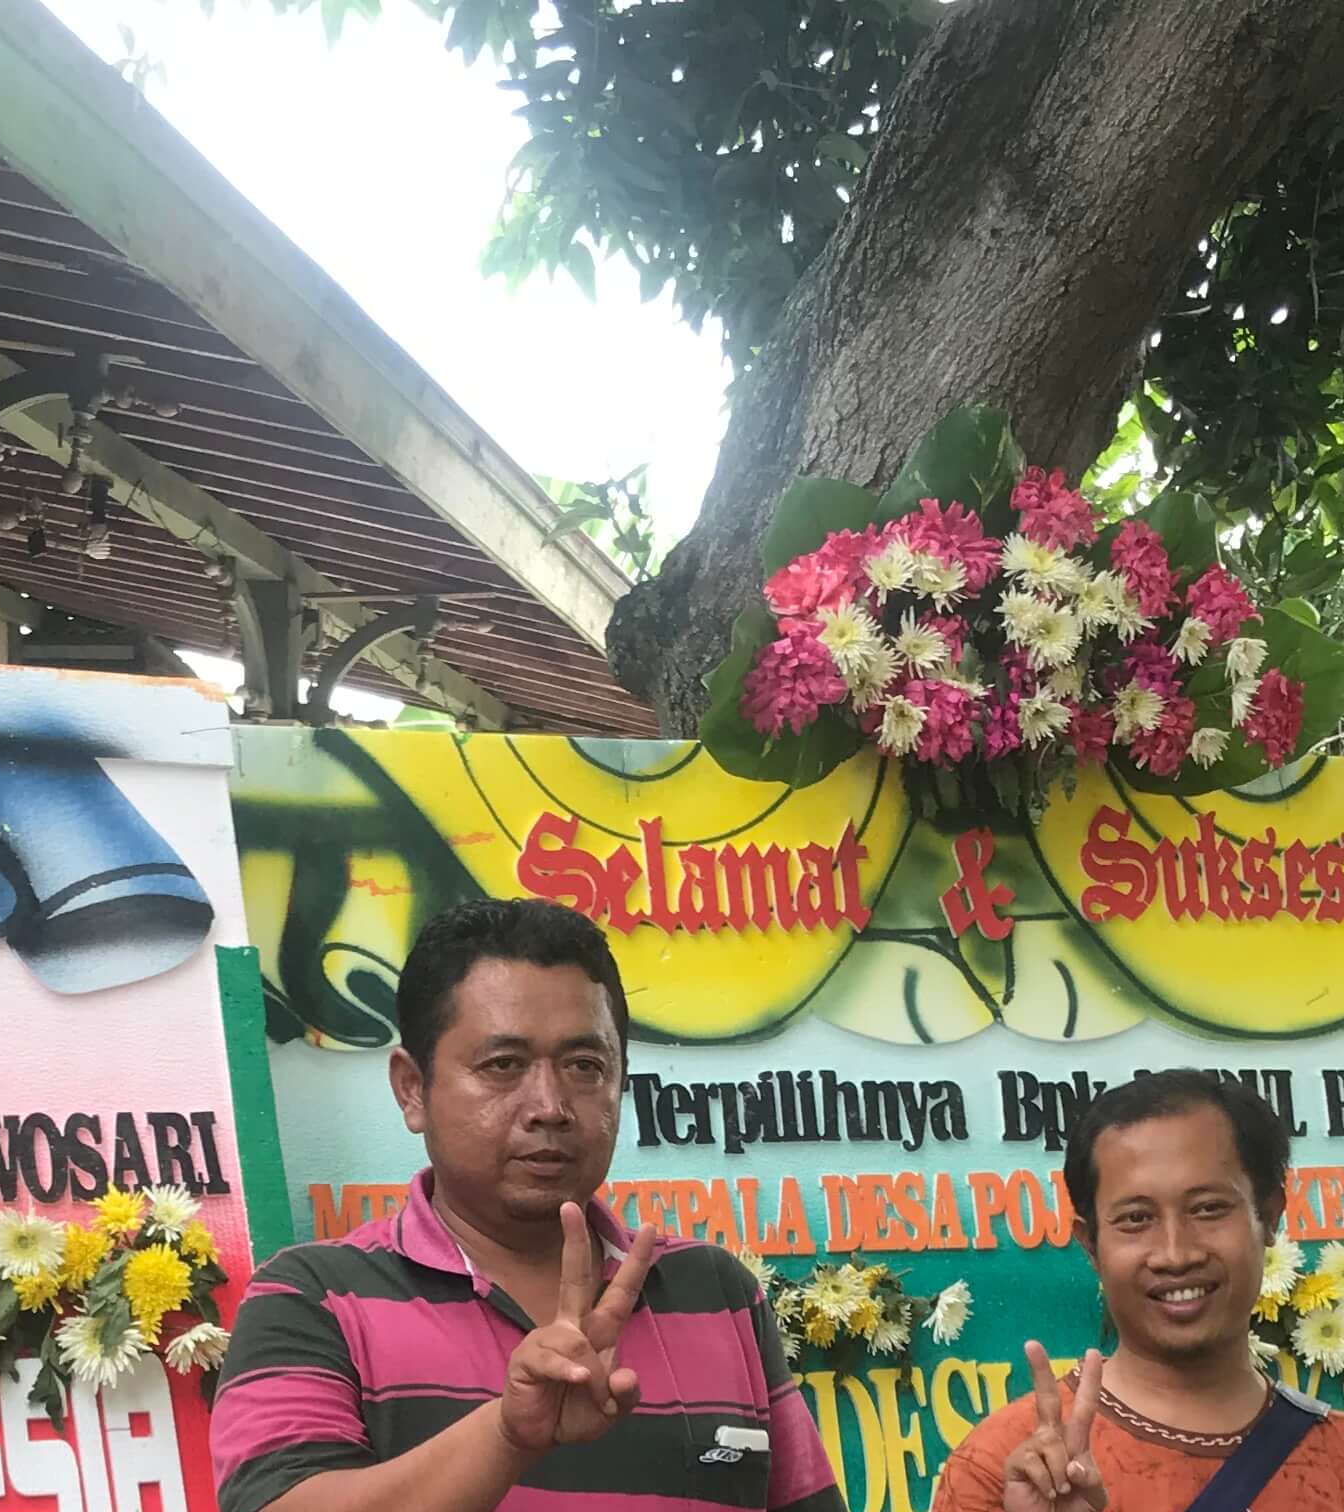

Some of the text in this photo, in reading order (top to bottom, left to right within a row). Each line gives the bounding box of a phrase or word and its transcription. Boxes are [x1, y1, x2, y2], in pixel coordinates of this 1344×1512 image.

[517, 810, 872, 936] Selamat
[939, 826, 1016, 941] &
[625, 1070, 968, 1154] Terpilihnya
[820, 1172, 951, 1252] DESA
